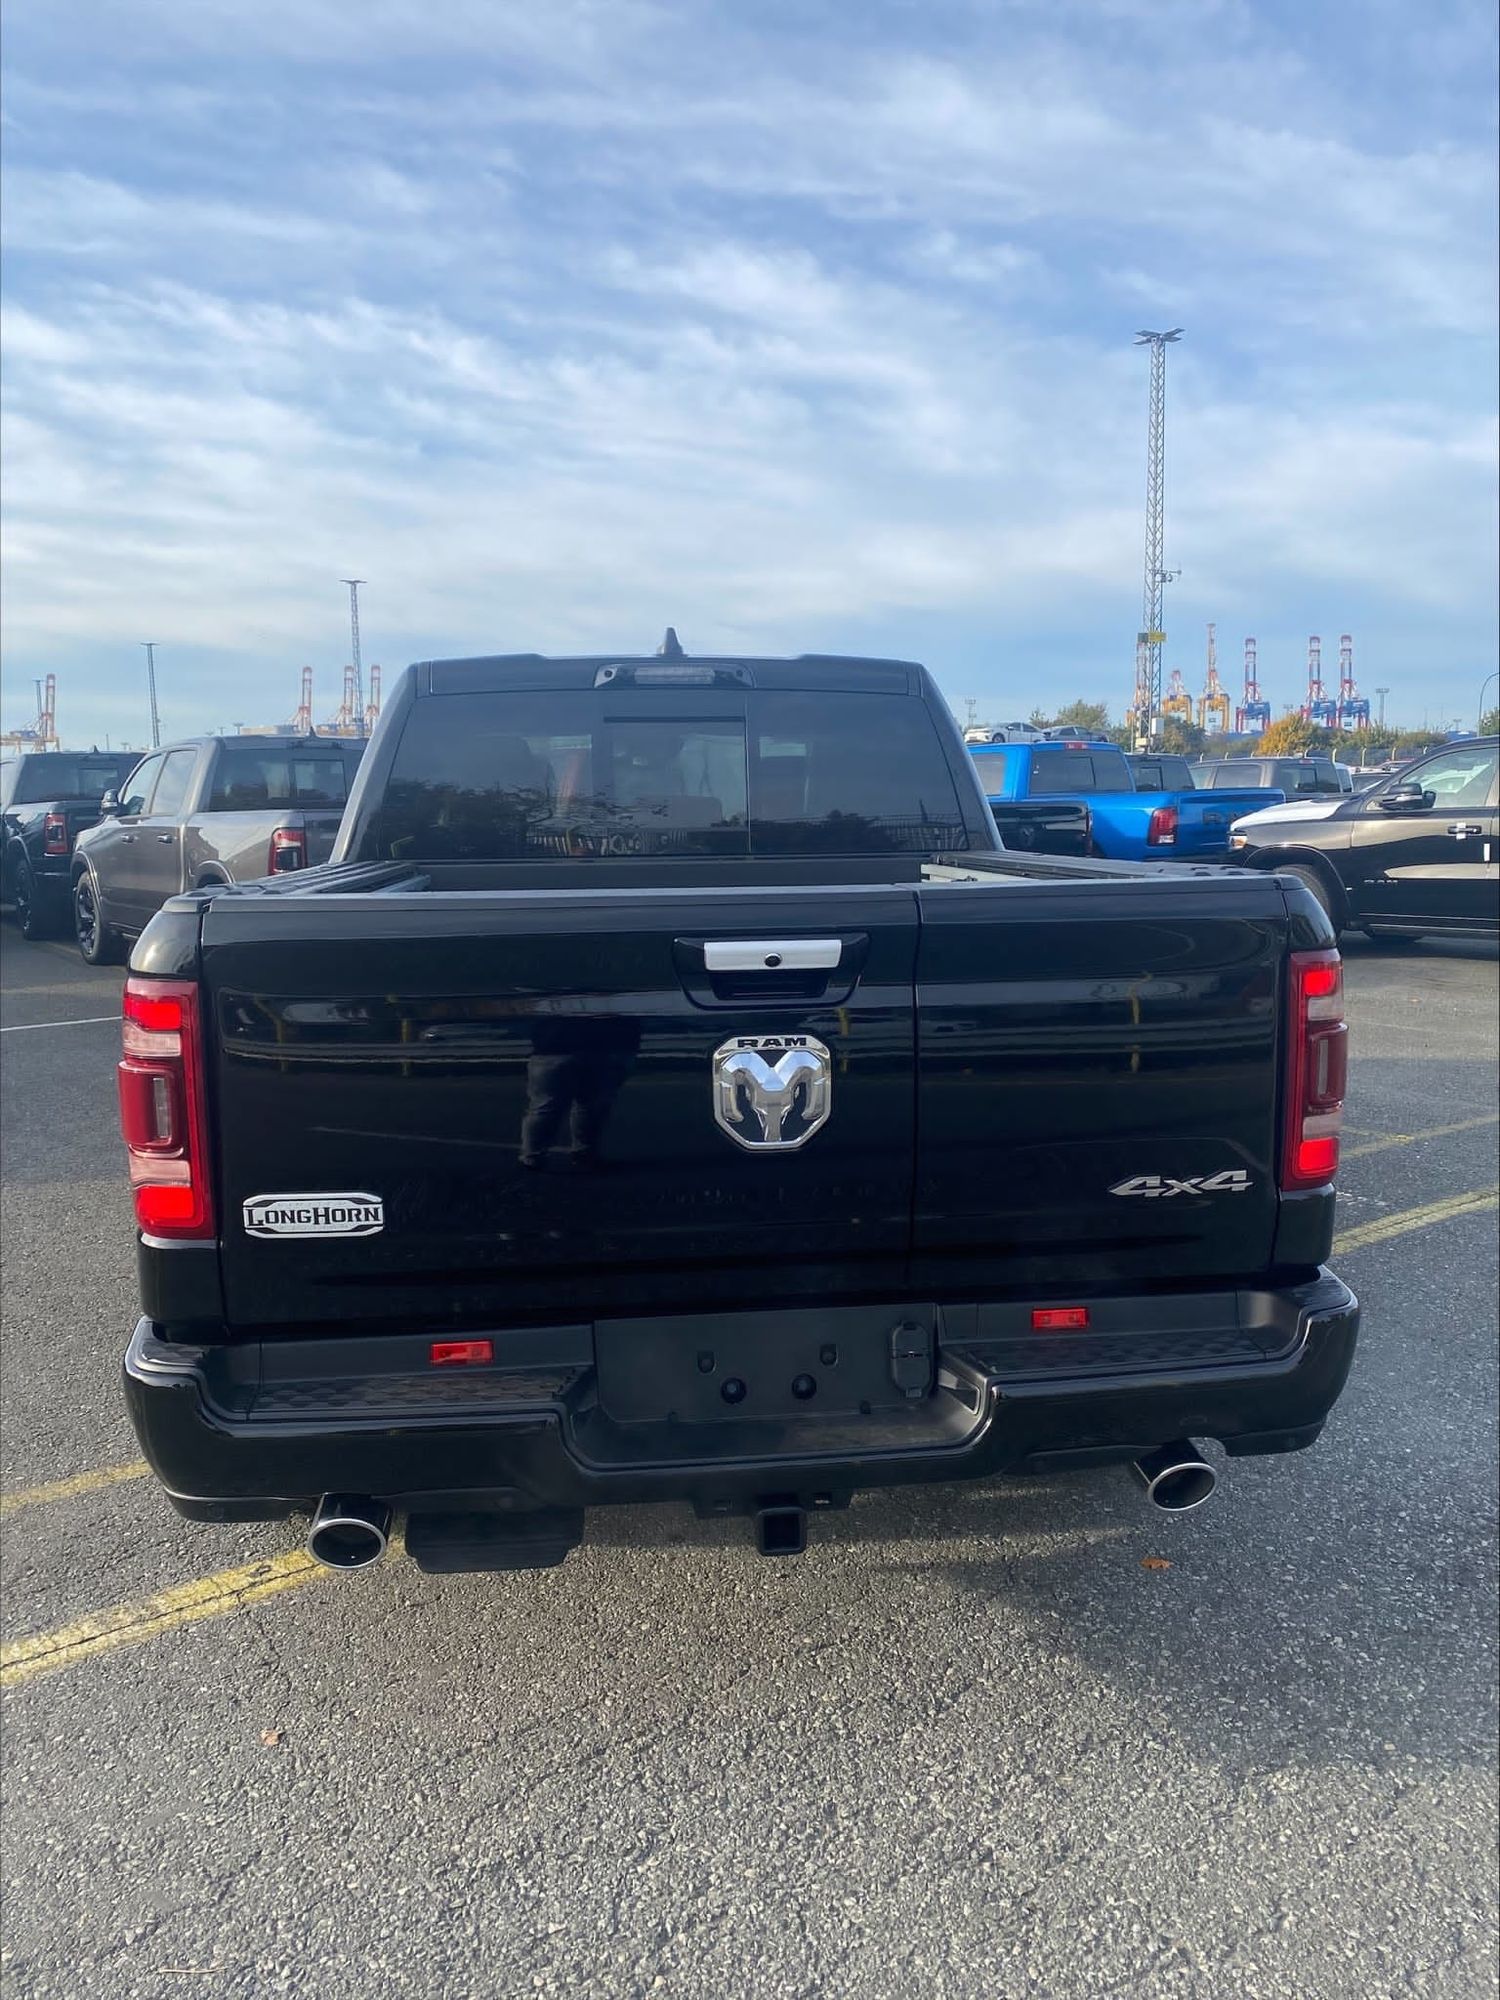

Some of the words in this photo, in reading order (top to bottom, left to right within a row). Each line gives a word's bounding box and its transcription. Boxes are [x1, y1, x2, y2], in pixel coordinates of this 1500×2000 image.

[737, 1037, 807, 1048] RAM
[1109, 1170, 1253, 1198] 4x4
[247, 1206, 381, 1227] LONGHORN
